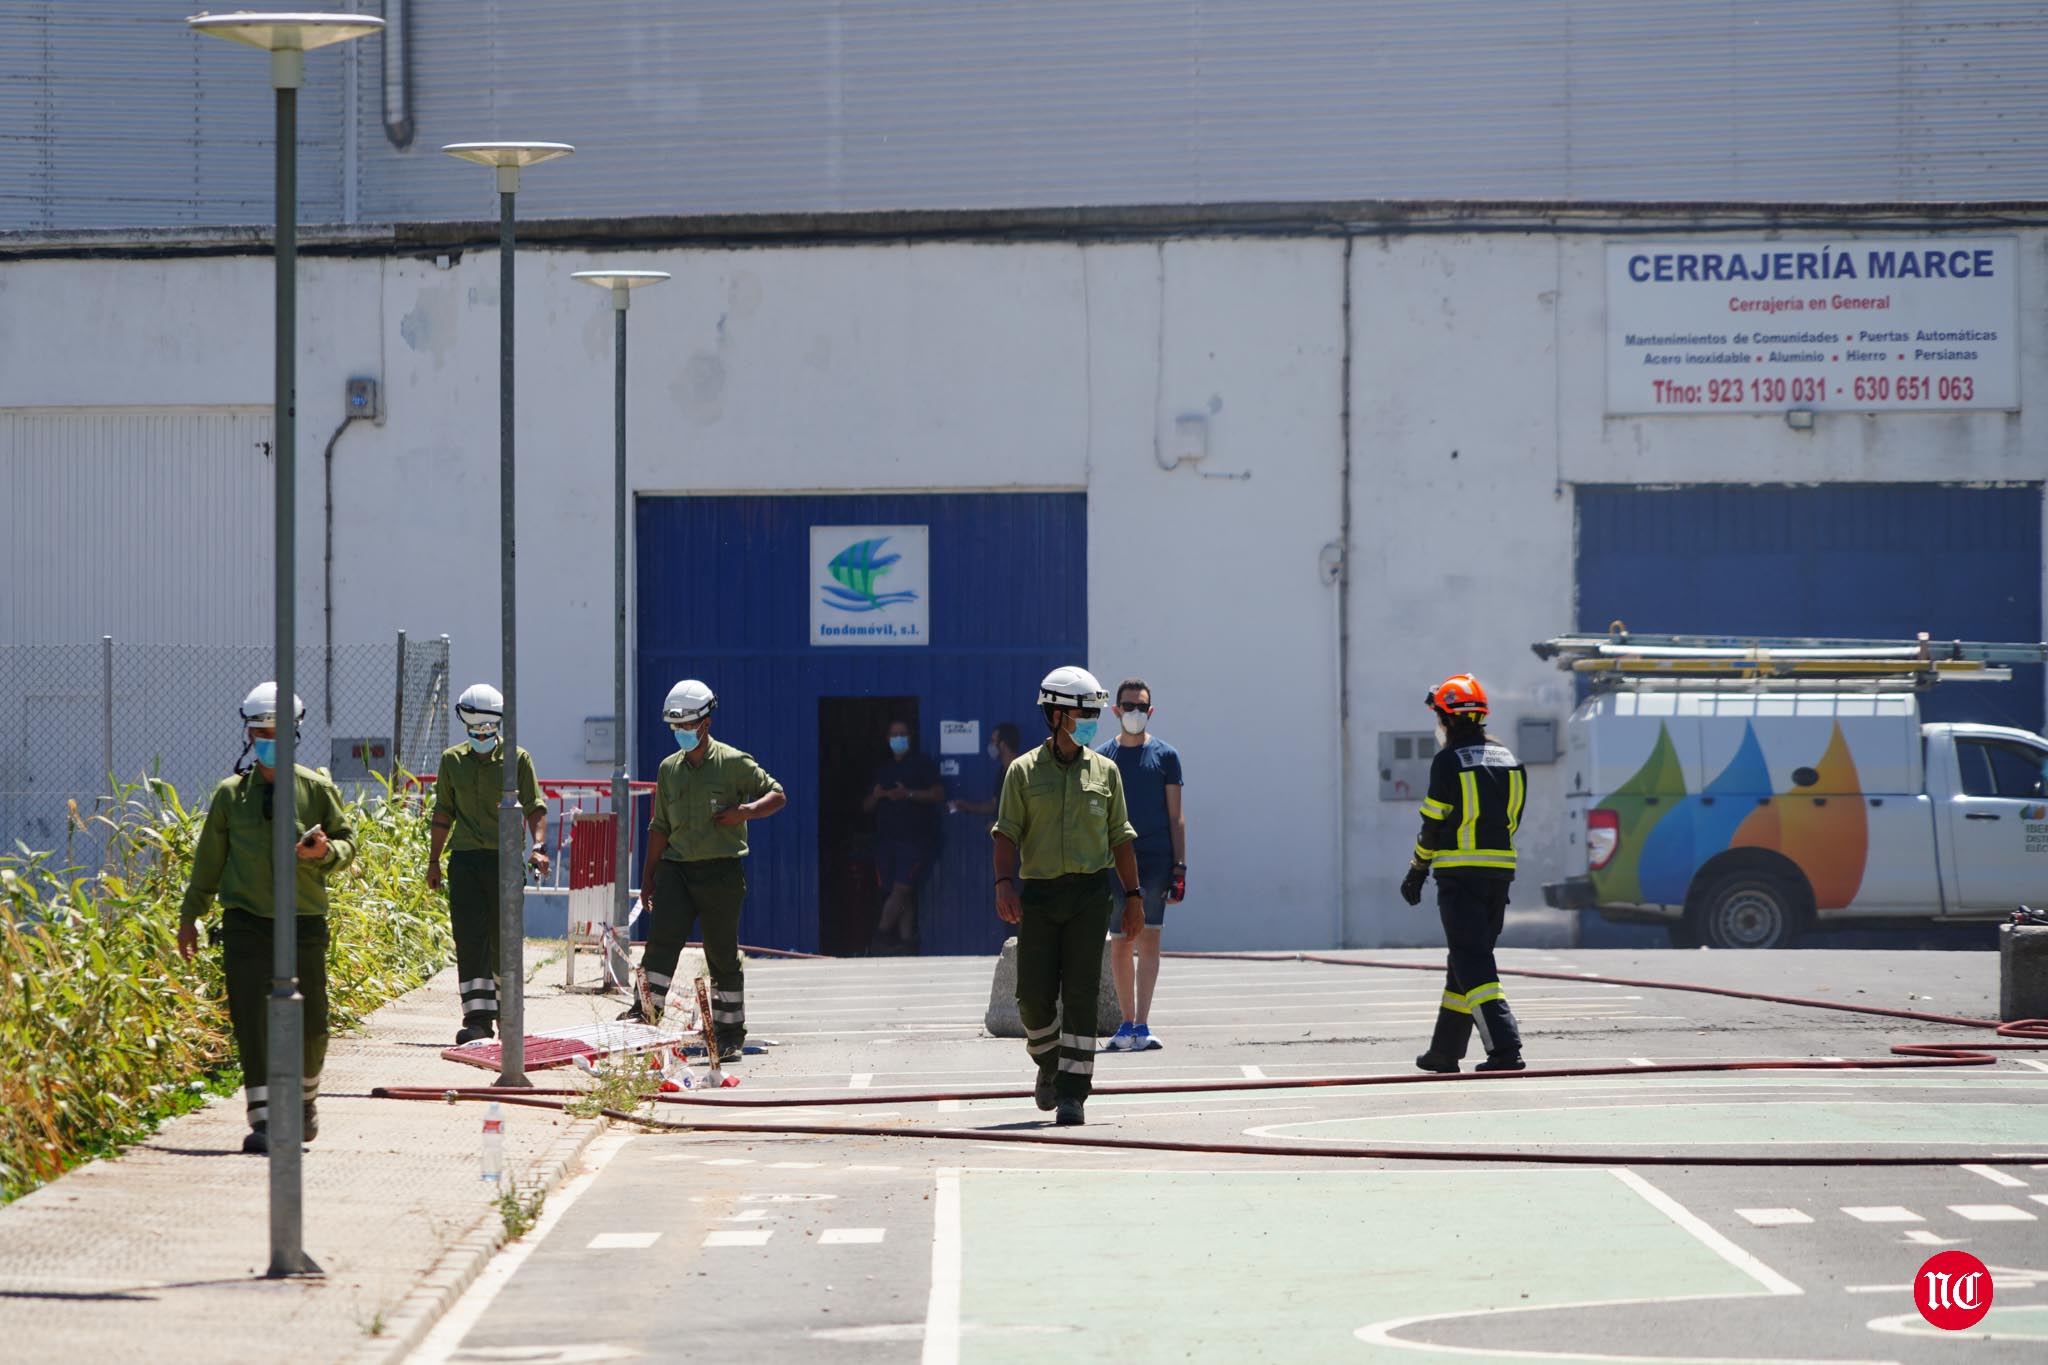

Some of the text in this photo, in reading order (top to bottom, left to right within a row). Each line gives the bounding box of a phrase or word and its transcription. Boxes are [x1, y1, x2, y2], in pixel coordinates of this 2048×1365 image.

[1628, 245, 1994, 282] CERRAJERÍA MARCE
[1808, 298, 1827, 310] en
[1832, 294, 1890, 310] General
[1625, 329, 1998, 346] Mantenimientos de Comunidades Puertas Automáticas
[1643, 348, 1978, 365] Acero inoxidable Aluminio Hierro Persianas
[1652, 380, 1702, 403] Tfno:
[1708, 378, 1743, 403] 923
[1751, 377, 1785, 403] 130
[1792, 376, 1826, 402] 031
[1854, 376, 1889, 401] 630
[1896, 376, 1930, 400] 651
[1938, 376, 1974, 401] 063
